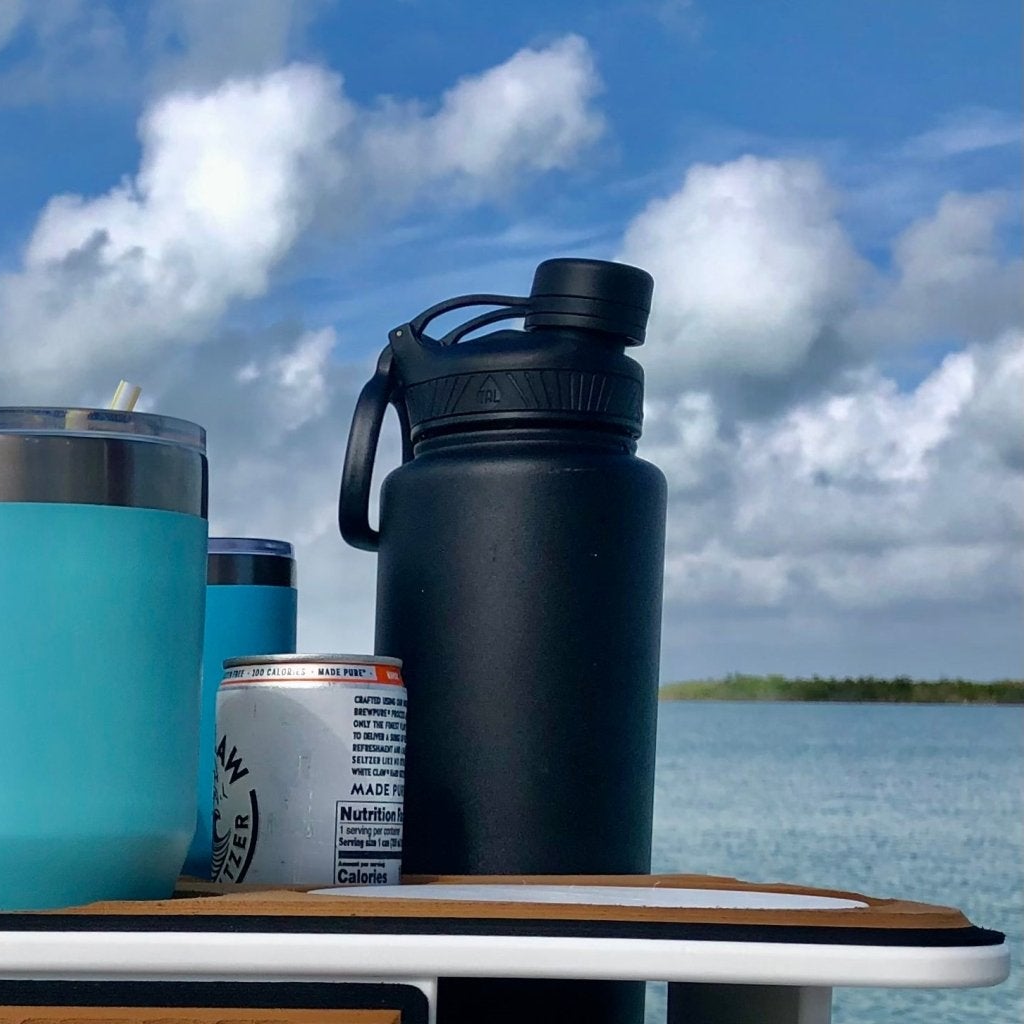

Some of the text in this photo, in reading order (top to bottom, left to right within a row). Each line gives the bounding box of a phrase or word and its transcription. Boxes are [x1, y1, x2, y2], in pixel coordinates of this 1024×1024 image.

[252, 668, 264, 677] 100
[318, 668, 341, 676] MADE
[354, 695, 381, 704] CRAFTED
[353, 719, 371, 729] ONLY
[373, 720, 384, 729] THE
[353, 732, 362, 740] TO
[363, 732, 384, 741] DELIVER
[353, 744, 393, 753] REFRESHMENT
[352, 755, 381, 765] SELTZER
[351, 767, 372, 776] WHITE
[350, 783, 390, 796] MADE
[340, 806, 396, 822] Nutrition
[340, 826, 344, 834] 1
[346, 826, 372, 838] serving
[373, 827, 383, 837] per
[339, 837, 364, 849] Serving
[337, 868, 388, 884] Calories
